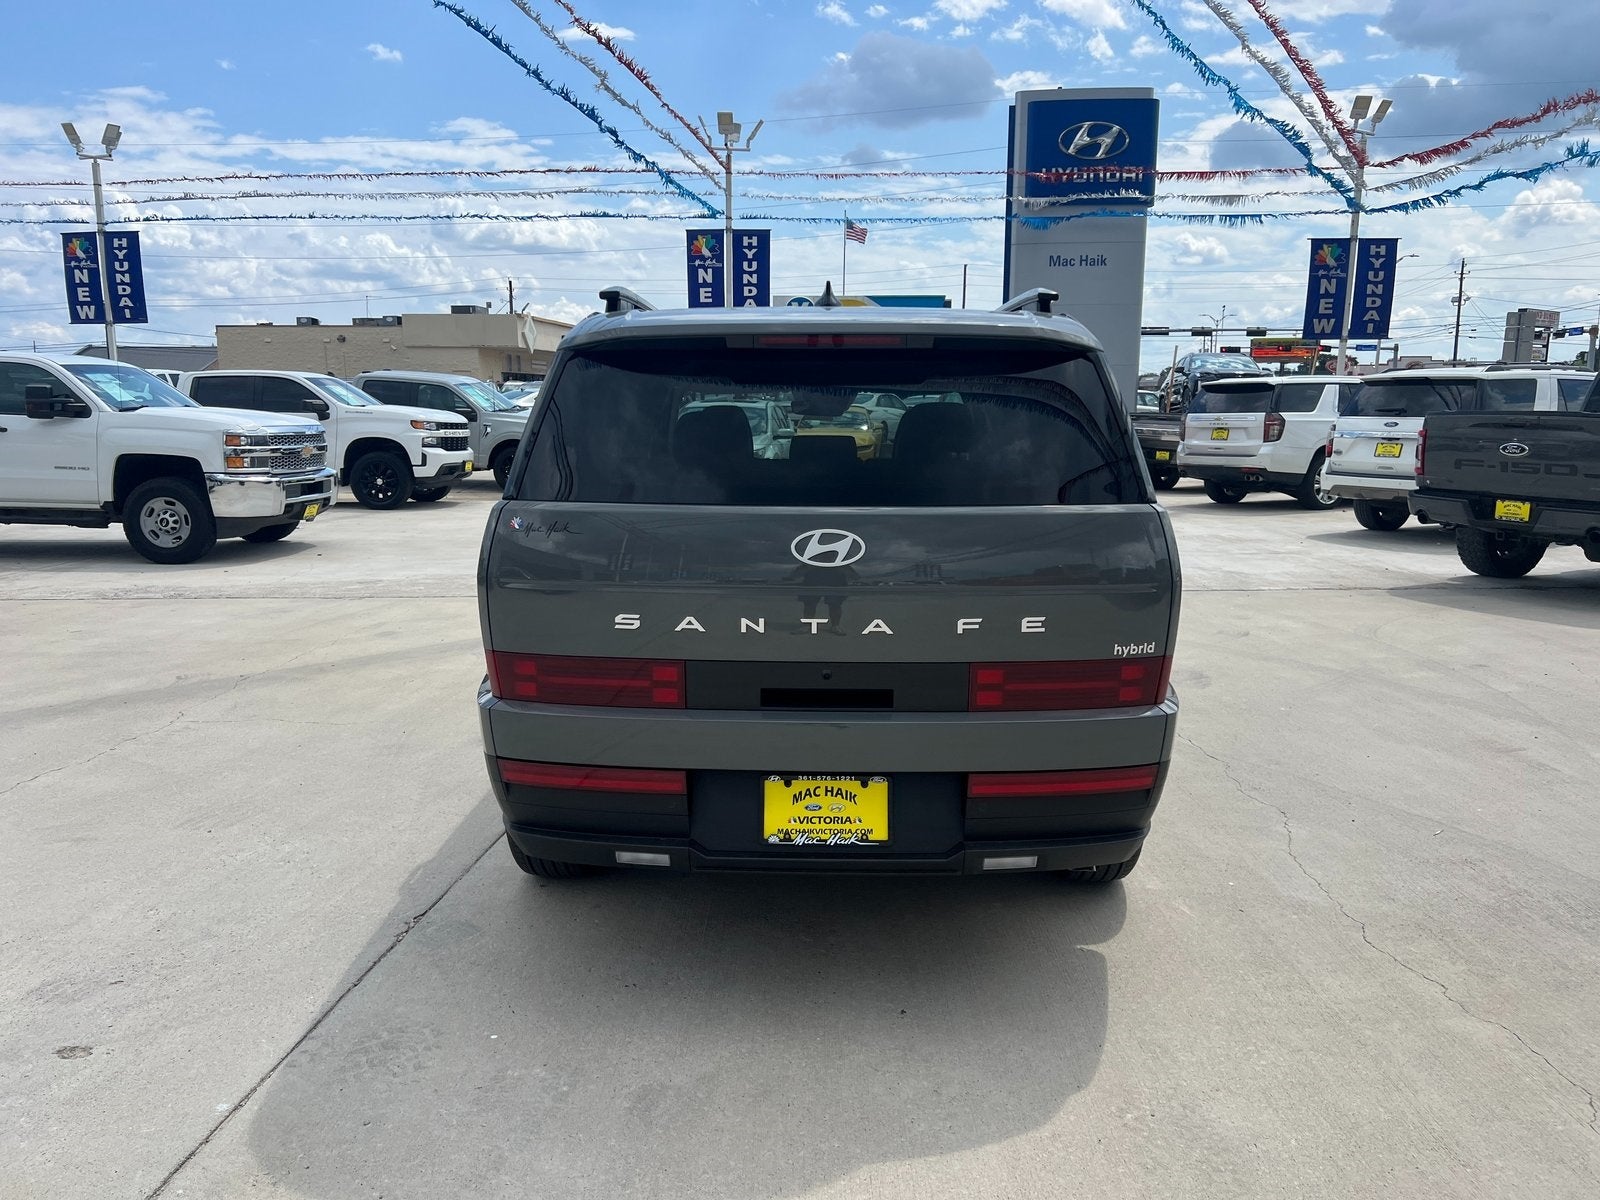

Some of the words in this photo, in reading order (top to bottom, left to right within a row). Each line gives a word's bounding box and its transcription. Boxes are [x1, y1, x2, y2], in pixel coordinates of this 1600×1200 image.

[1048, 255, 1076, 267] Mac
[1079, 254, 1108, 267] Haik
[113, 238, 135, 318] HYUNDAI
[742, 236, 758, 308] HYUNDA
[73, 269, 96, 320] NEW
[697, 268, 713, 303] NE
[1363, 244, 1387, 334] HYUNDAI
[1312, 278, 1336, 334] NEW
[1454, 458, 1578, 476] F-150
[523, 522, 543, 538] Mac
[545, 520, 573, 538] Haik
[614, 614, 894, 636] SANTA
[956, 616, 1046, 635] FE
[1113, 641, 1156, 658] hybrid
[791, 785, 822, 806] MAC
[824, 785, 858, 806] HAIK
[797, 816, 854, 825] VICTORIA
[792, 832, 821, 846] Mac
[825, 832, 864, 846] Haik
